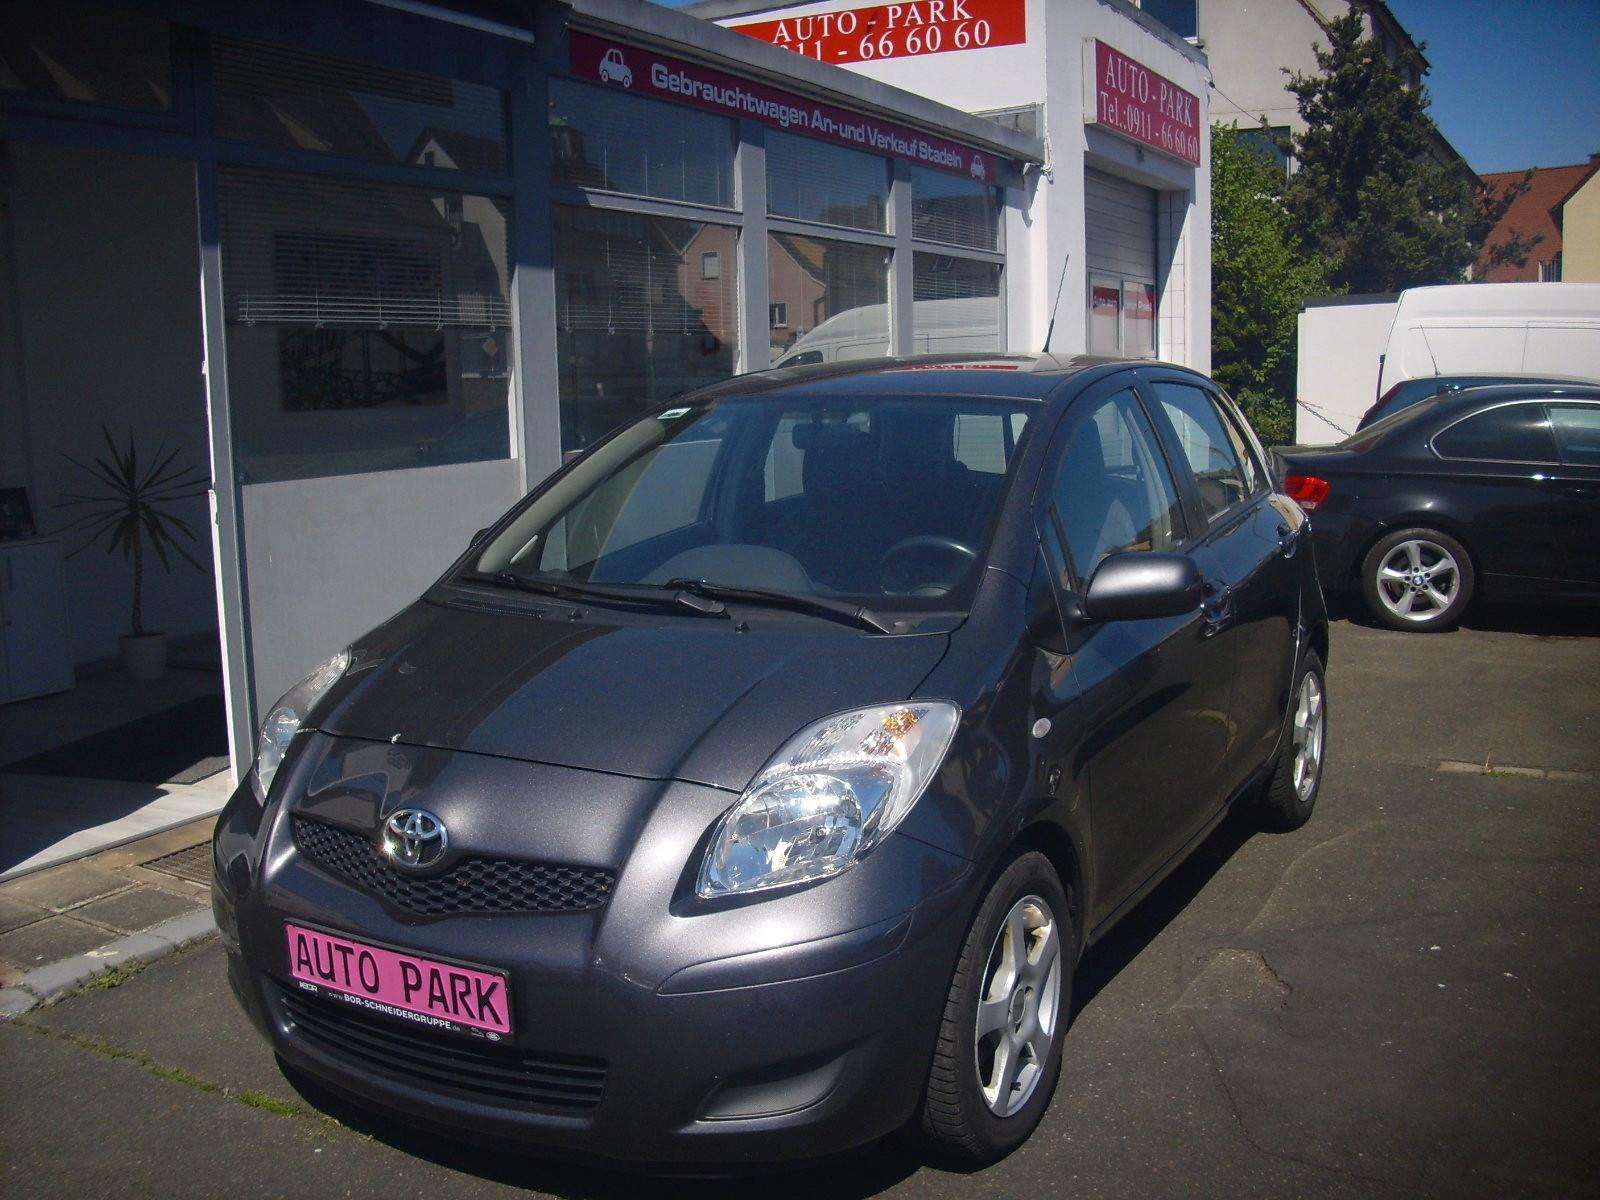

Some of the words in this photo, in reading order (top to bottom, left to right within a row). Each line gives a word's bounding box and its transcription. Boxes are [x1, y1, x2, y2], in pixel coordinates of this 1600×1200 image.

[772, 11, 857, 44] AUTO
[886, 0, 974, 28] PARK
[859, 31, 895, 59] 66
[906, 25, 942, 54] 60
[954, 20, 991, 49] 60
[651, 63, 808, 128] Gebrauchtwagen
[867, 125, 919, 157] Verkauf
[1105, 54, 1148, 103] AUTO
[1160, 81, 1193, 128] PARK
[1161, 122, 1173, 150] 66
[1175, 129, 1186, 156] 60
[1187, 136, 1199, 161] 60
[297, 933, 380, 994] AUTO
[399, 959, 504, 1026] PARK
